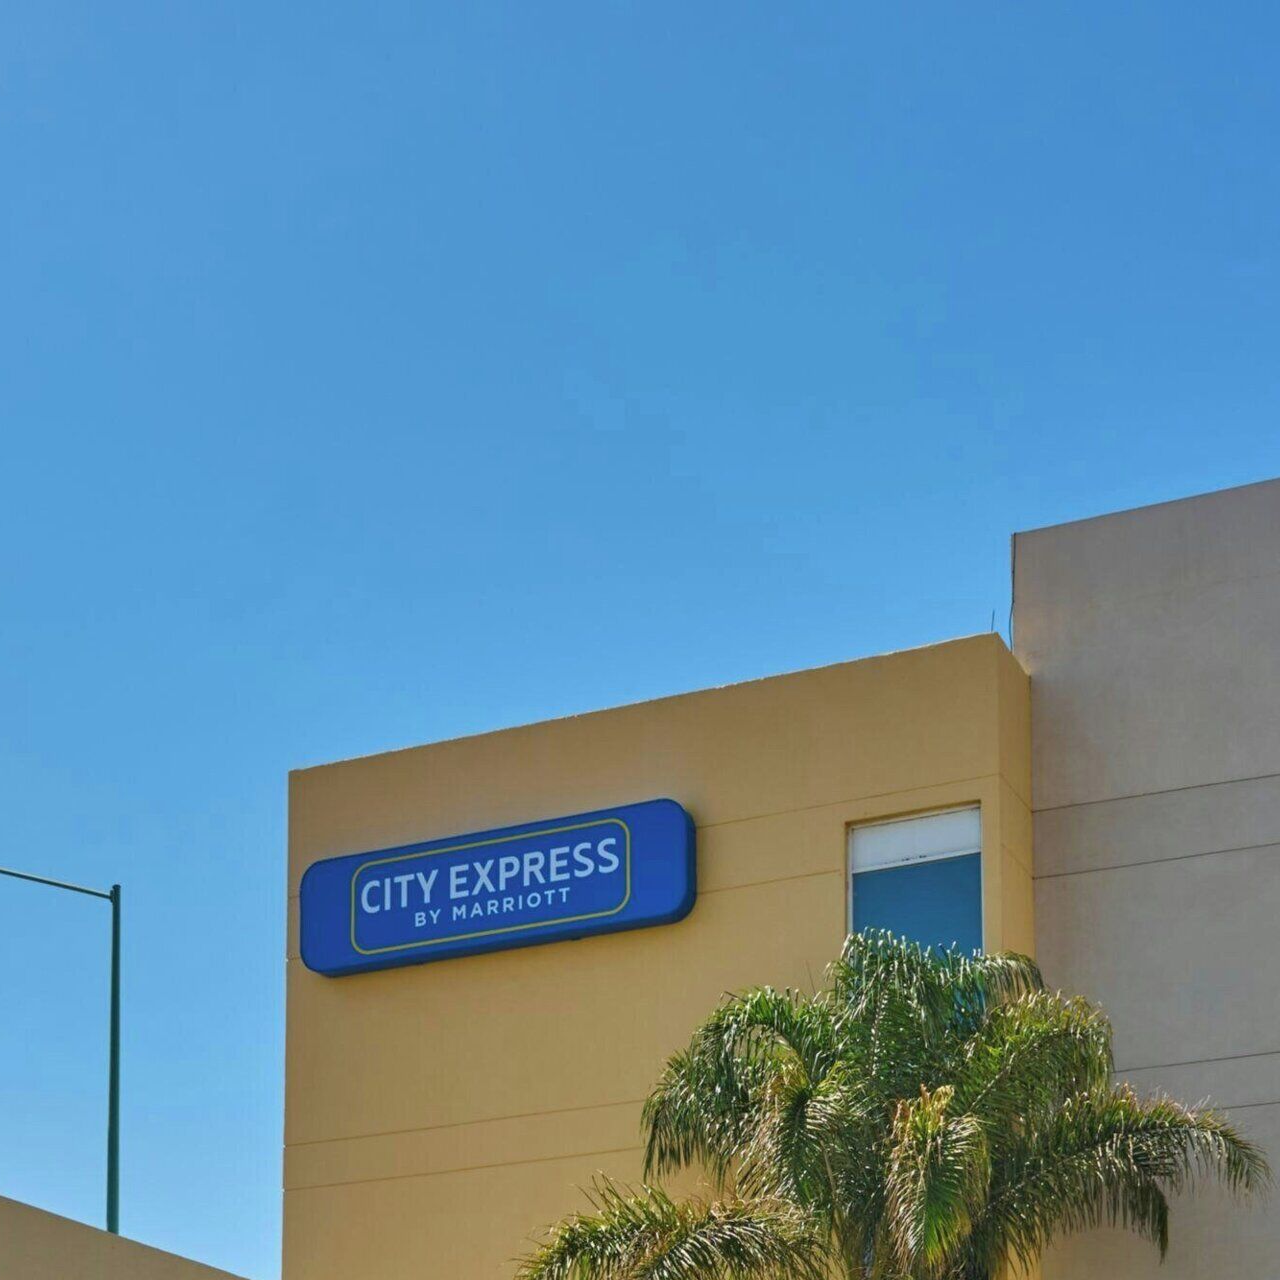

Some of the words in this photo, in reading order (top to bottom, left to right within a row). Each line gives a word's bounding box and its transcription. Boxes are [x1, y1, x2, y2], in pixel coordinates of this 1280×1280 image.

[360, 868, 439, 914] CITY
[449, 837, 620, 900] EXPRESS
[414, 908, 441, 927] BY
[452, 887, 571, 921] MARRIOTT
